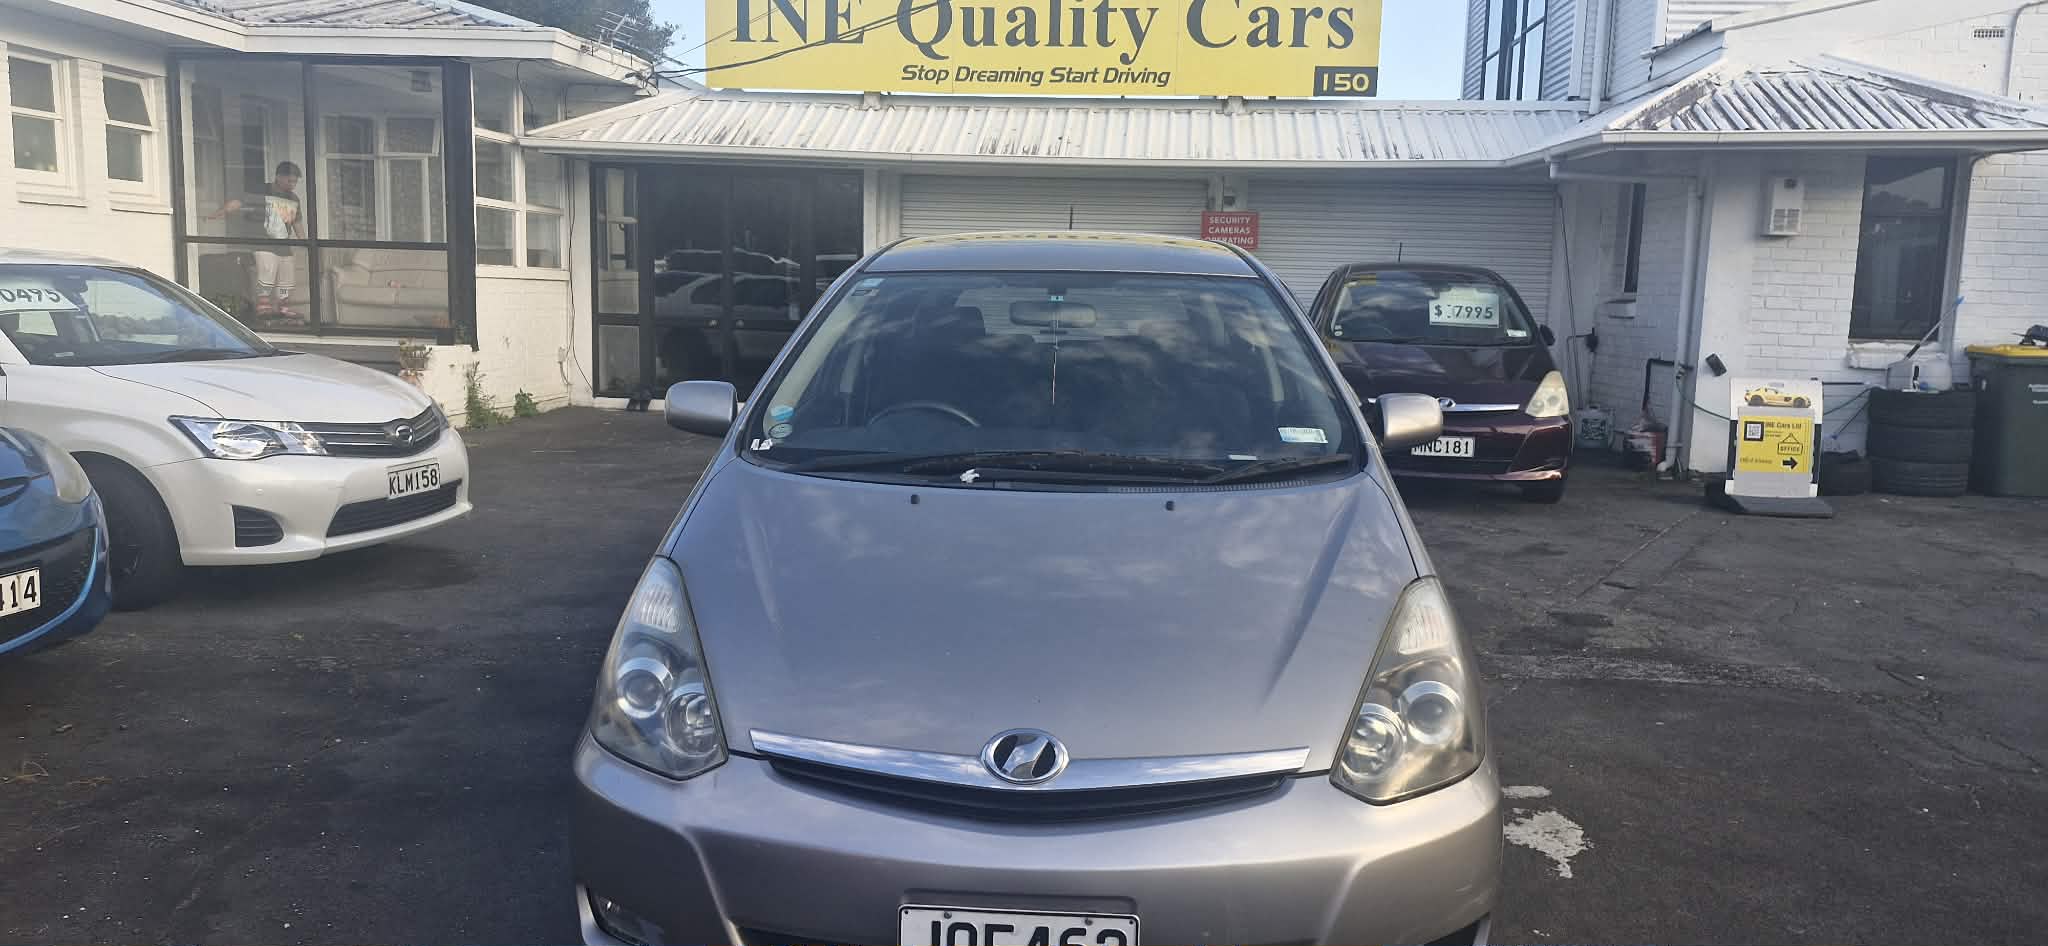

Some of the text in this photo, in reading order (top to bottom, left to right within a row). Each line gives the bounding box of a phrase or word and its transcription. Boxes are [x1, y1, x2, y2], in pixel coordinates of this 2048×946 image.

[731, 0, 1354, 65] INE Quality Cars
[901, 64, 1171, 87] Stop Dreaming Start Driving
[1321, 73, 1370, 93] 150
[1208, 216, 1250, 224] SECURITY
[1208, 226, 1250, 234] CAMERAS
[389, 468, 438, 497] KLM158
